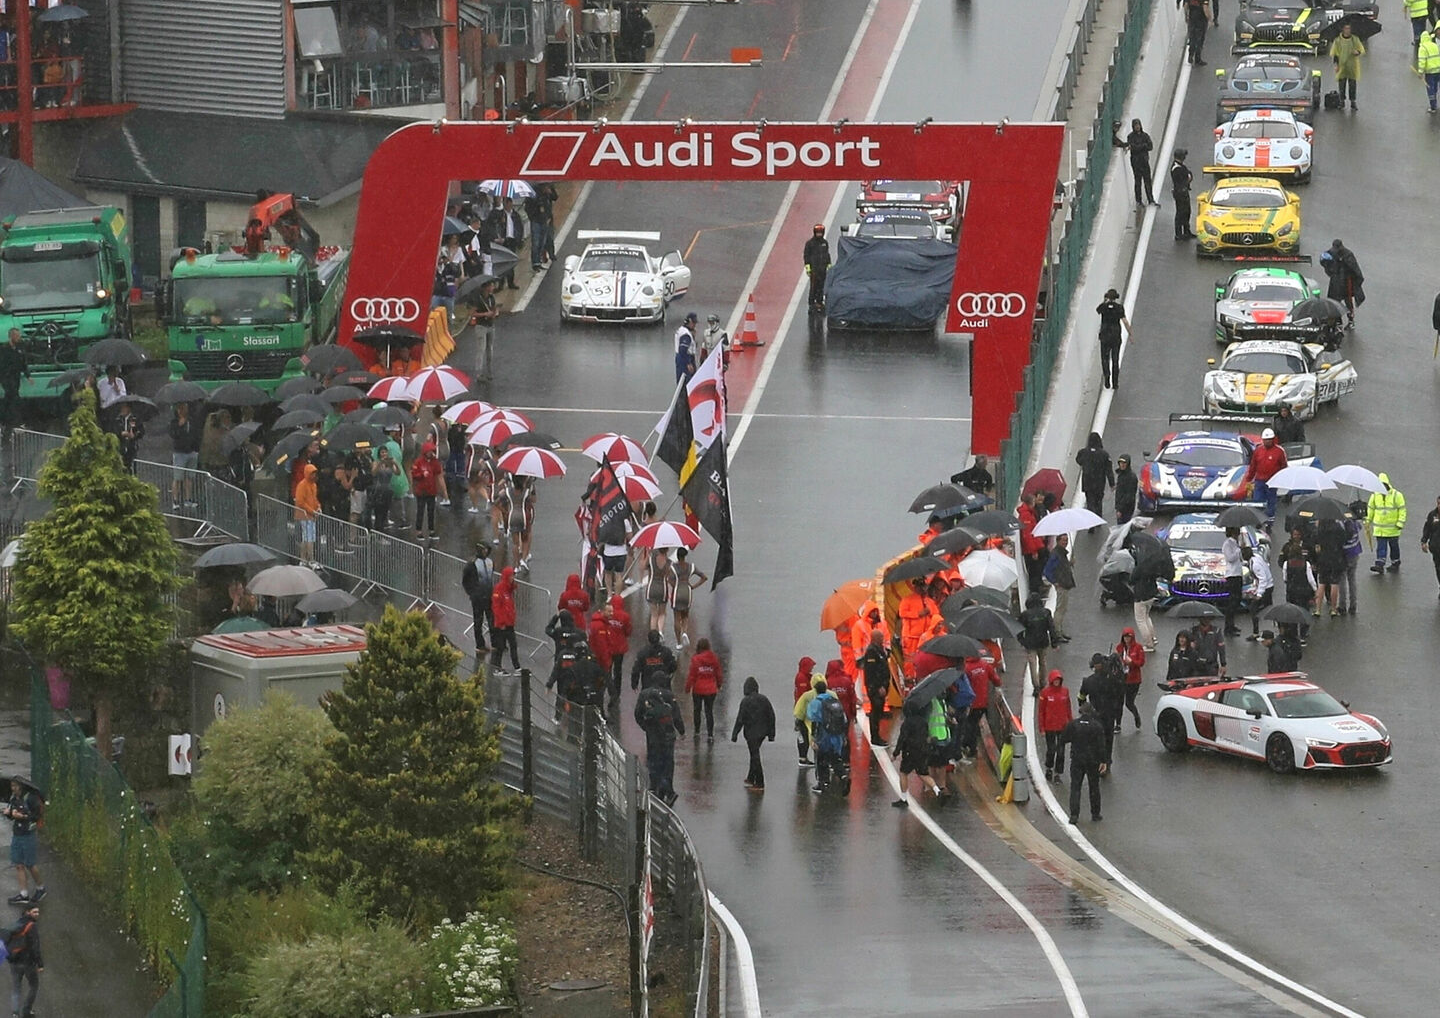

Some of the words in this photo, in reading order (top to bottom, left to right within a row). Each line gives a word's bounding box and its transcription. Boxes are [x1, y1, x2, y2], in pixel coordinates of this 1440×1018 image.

[589, 132, 712, 167] Audi
[731, 132, 881, 176] Sport
[594, 284, 611, 296] 53
[960, 318, 988, 328] Audi
[243, 335, 280, 346] Stassart
